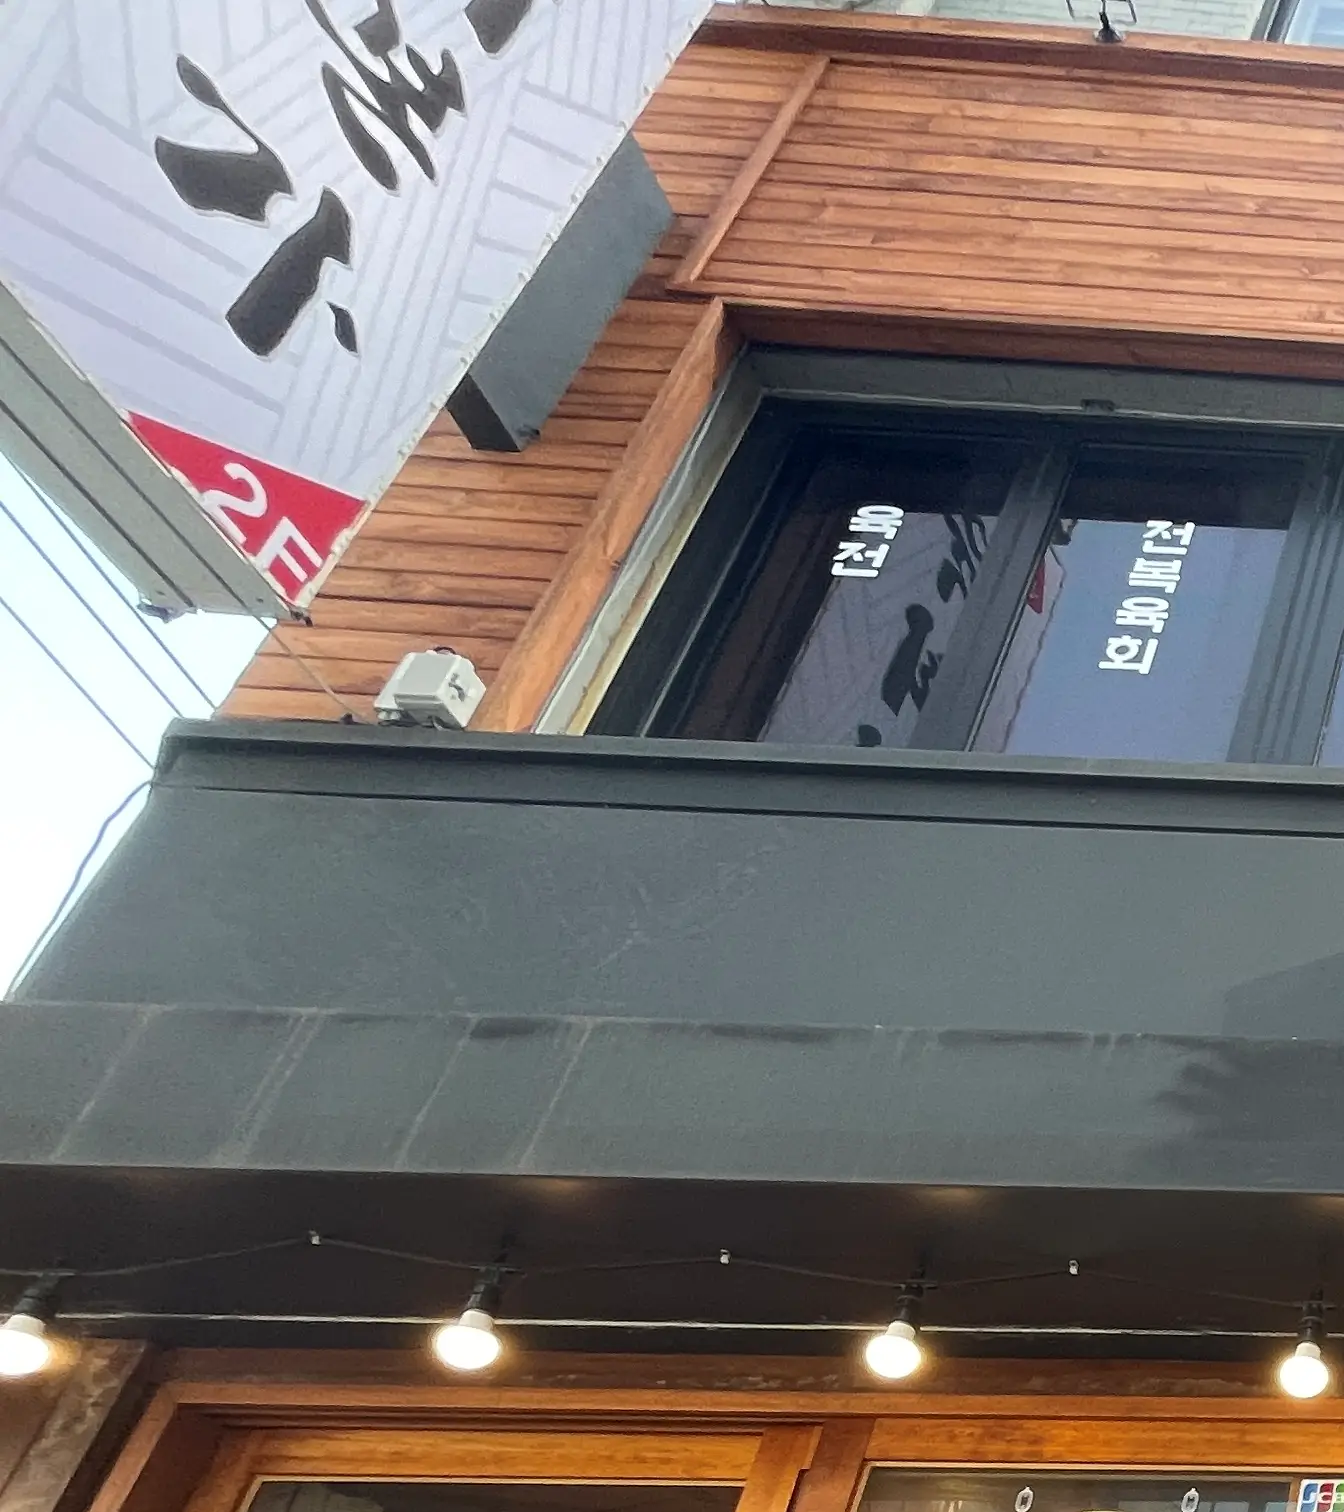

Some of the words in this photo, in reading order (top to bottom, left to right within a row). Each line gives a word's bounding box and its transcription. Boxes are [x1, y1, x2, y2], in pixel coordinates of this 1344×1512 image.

[196, 462, 323, 598] 2F
[831, 503, 906, 579] 육전
[1098, 519, 1197, 675] 전복육회
